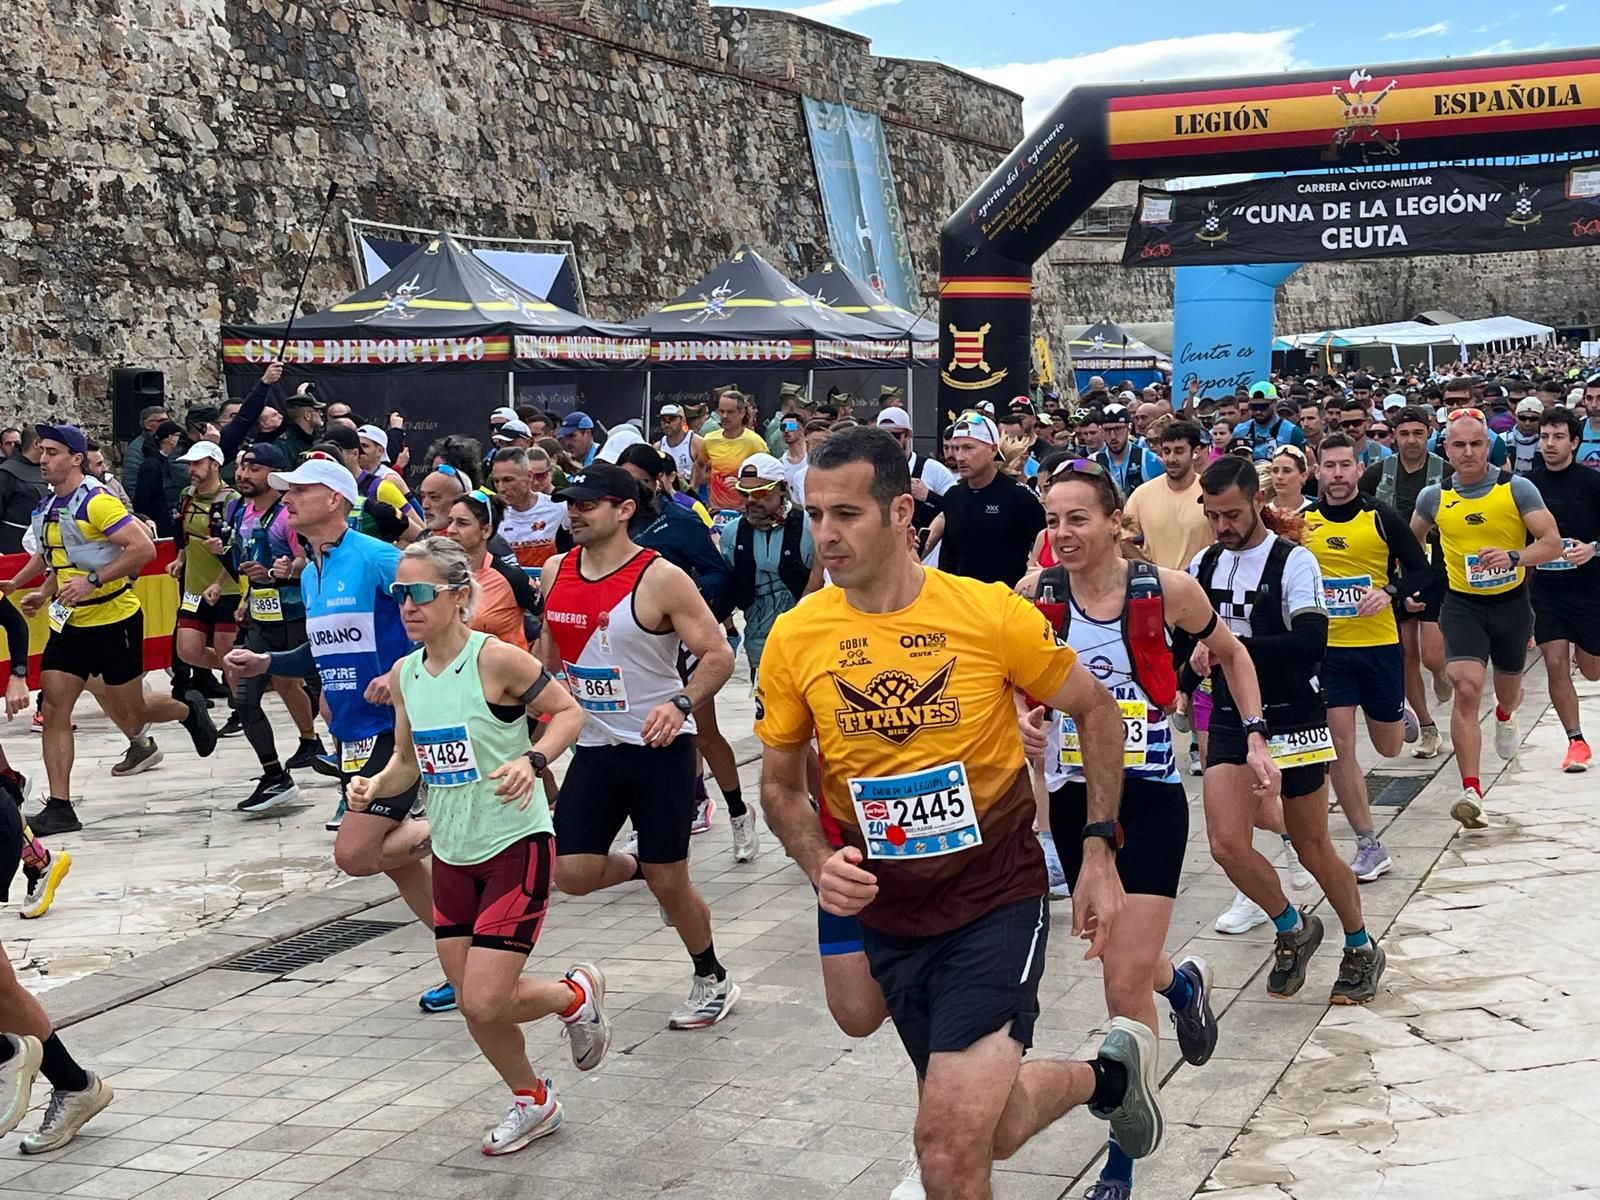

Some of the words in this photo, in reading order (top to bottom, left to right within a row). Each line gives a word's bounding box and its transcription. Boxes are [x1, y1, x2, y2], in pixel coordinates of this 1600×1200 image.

[1174, 105, 1270, 135] LEGIÓN
[1433, 83, 1582, 116] ESPAÑOLA
[1297, 182, 1346, 194] CARRERA
[1348, 176, 1433, 191] CÍVICO-MILITAR
[1322, 201, 1352, 221] DE
[1359, 199, 1388, 219] LA
[1321, 224, 1408, 251] CEUTA
[323, 336, 484, 364] DEPORTIVO
[658, 338, 793, 361] DEPORTIVO
[1180, 342, 1232, 364] Ceuta
[1237, 347, 1255, 358] es
[546, 610, 588, 625] BOMBEROS
[312, 627, 362, 646] URBANO
[840, 637, 869, 651] GOBIK
[585, 679, 613, 696] 861
[840, 702, 957, 732] TITANES
[1287, 727, 1328, 747] 4808
[428, 742, 469, 765] 1482
[893, 788, 965, 827] 2445
